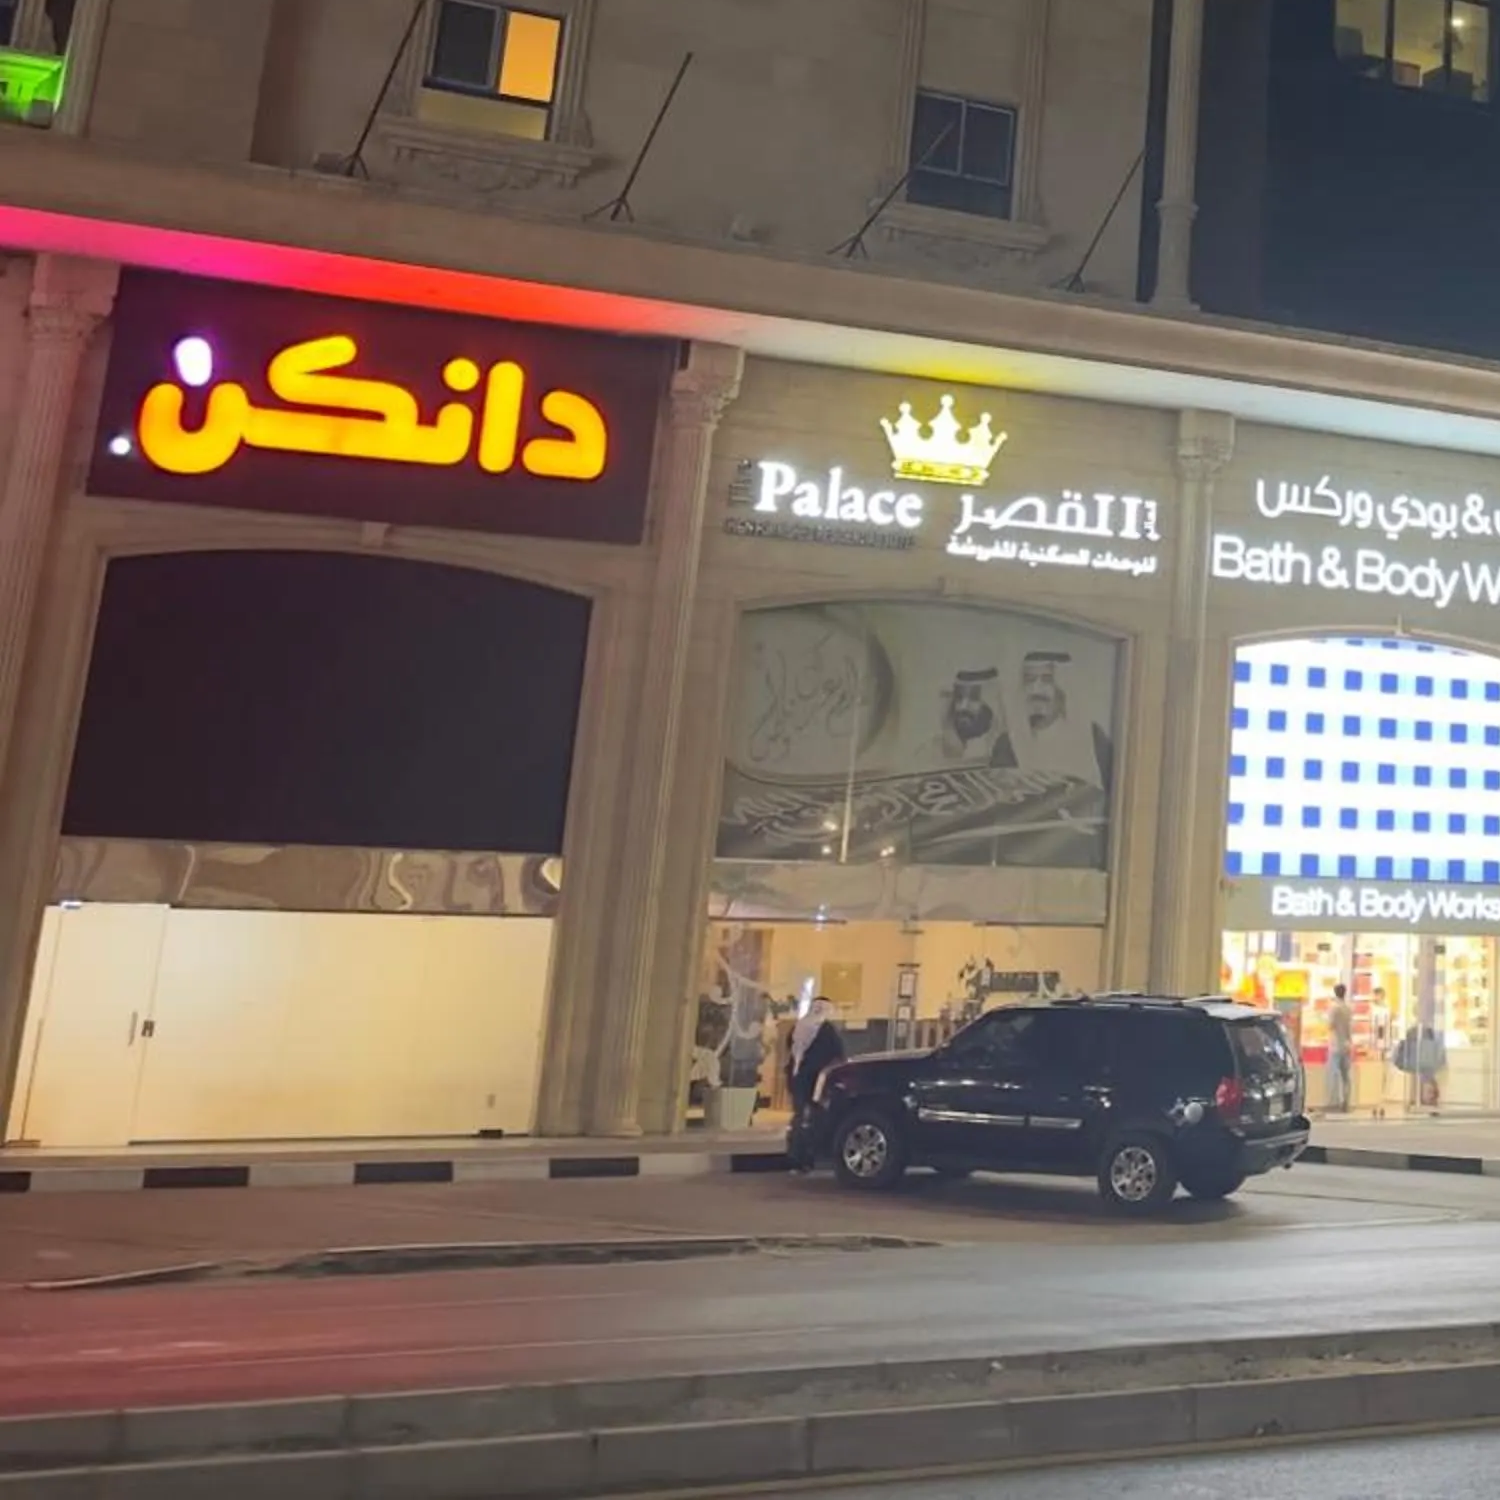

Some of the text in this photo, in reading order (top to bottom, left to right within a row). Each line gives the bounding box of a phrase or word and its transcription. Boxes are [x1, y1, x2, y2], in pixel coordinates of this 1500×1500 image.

[137, 335, 608, 481] دانكن
[753, 460, 924, 528] Palace
[1255, 475, 1373, 528] وركس
[1376, 493, 1458, 541] بودي
[1461, 493, 1492, 536] &
[1212, 533, 1311, 585] Bath
[1317, 546, 1350, 590] &
[1354, 549, 1459, 609] Body
[1271, 885, 1333, 916] Bath
[1336, 887, 1357, 916] &
[1358, 888, 1427, 924] Body
